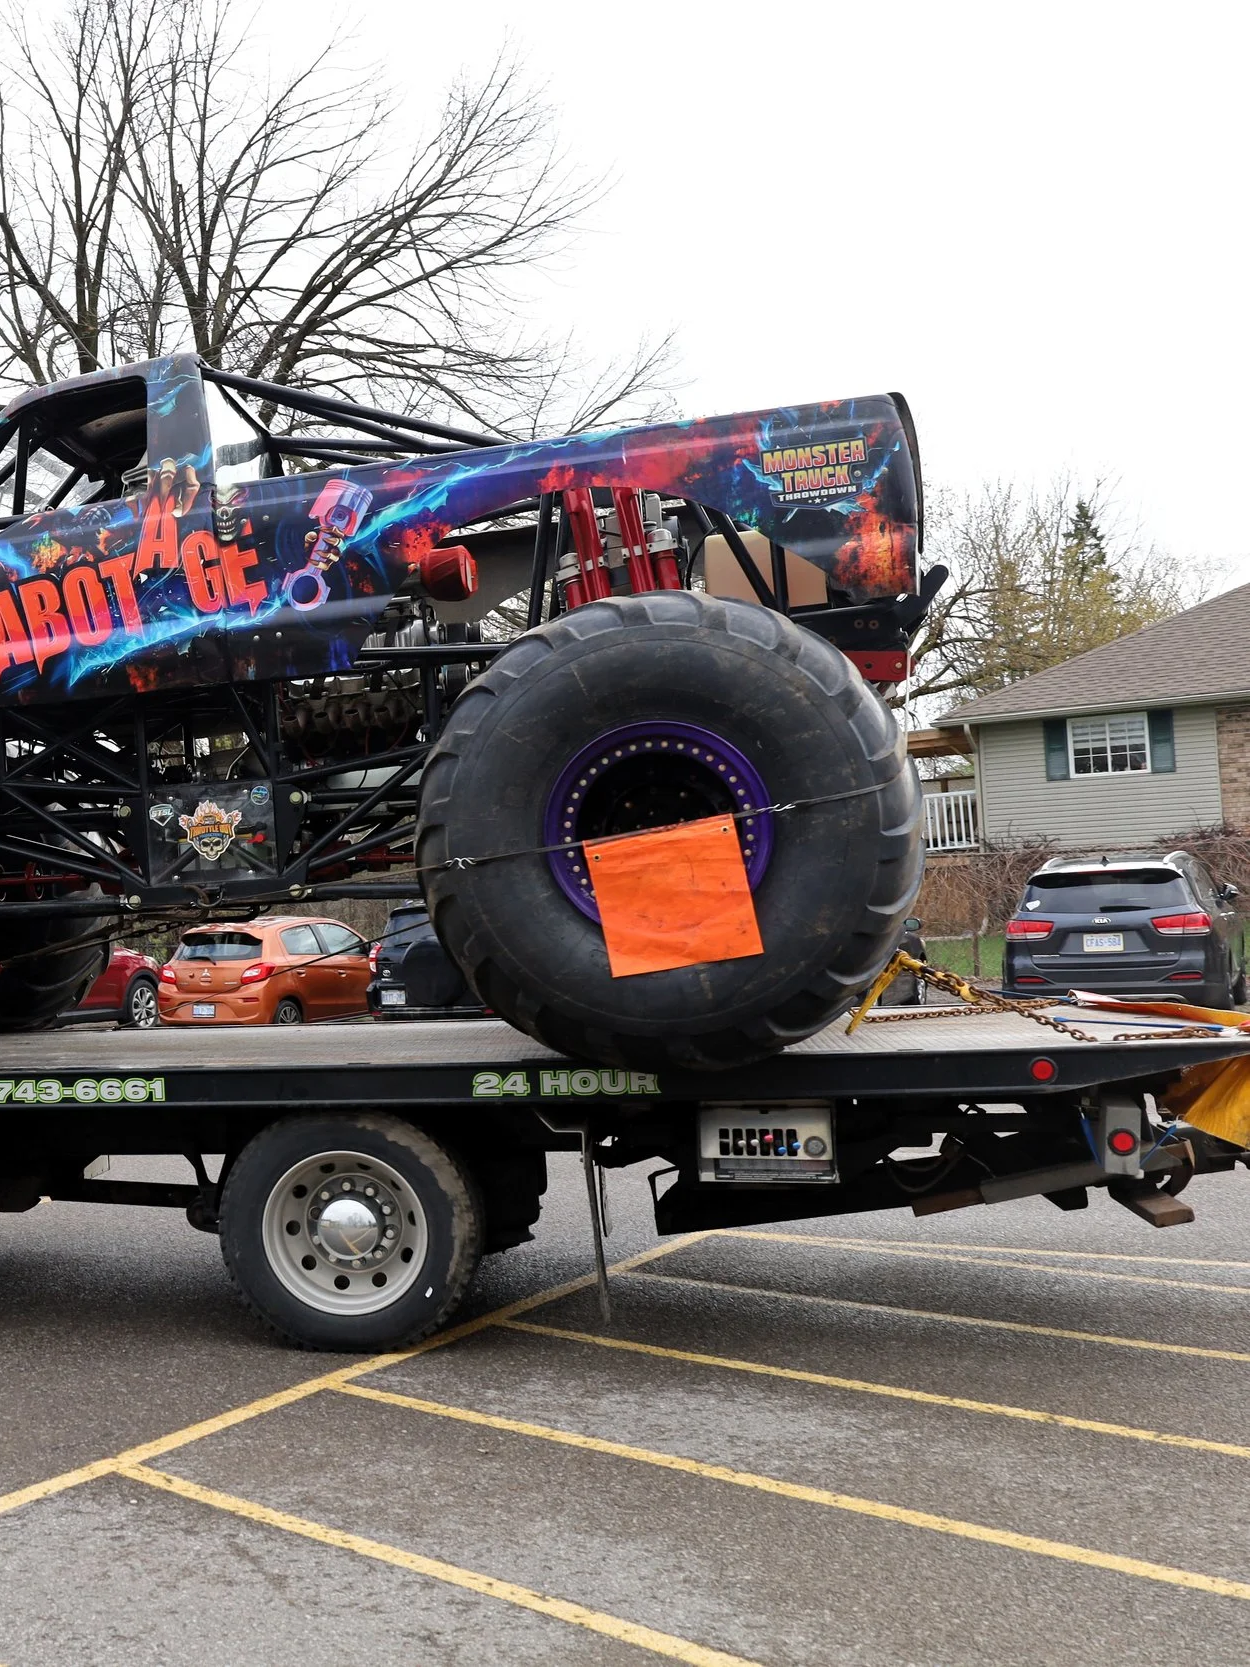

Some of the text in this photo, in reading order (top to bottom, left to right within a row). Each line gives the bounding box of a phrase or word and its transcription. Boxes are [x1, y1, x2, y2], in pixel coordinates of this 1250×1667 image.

[762, 439, 866, 474] MONSTER
[781, 464, 851, 493] TRUCK
[777, 485, 857, 502] THROWDOWN
[473, 1069, 662, 1097] 24 HOUR
